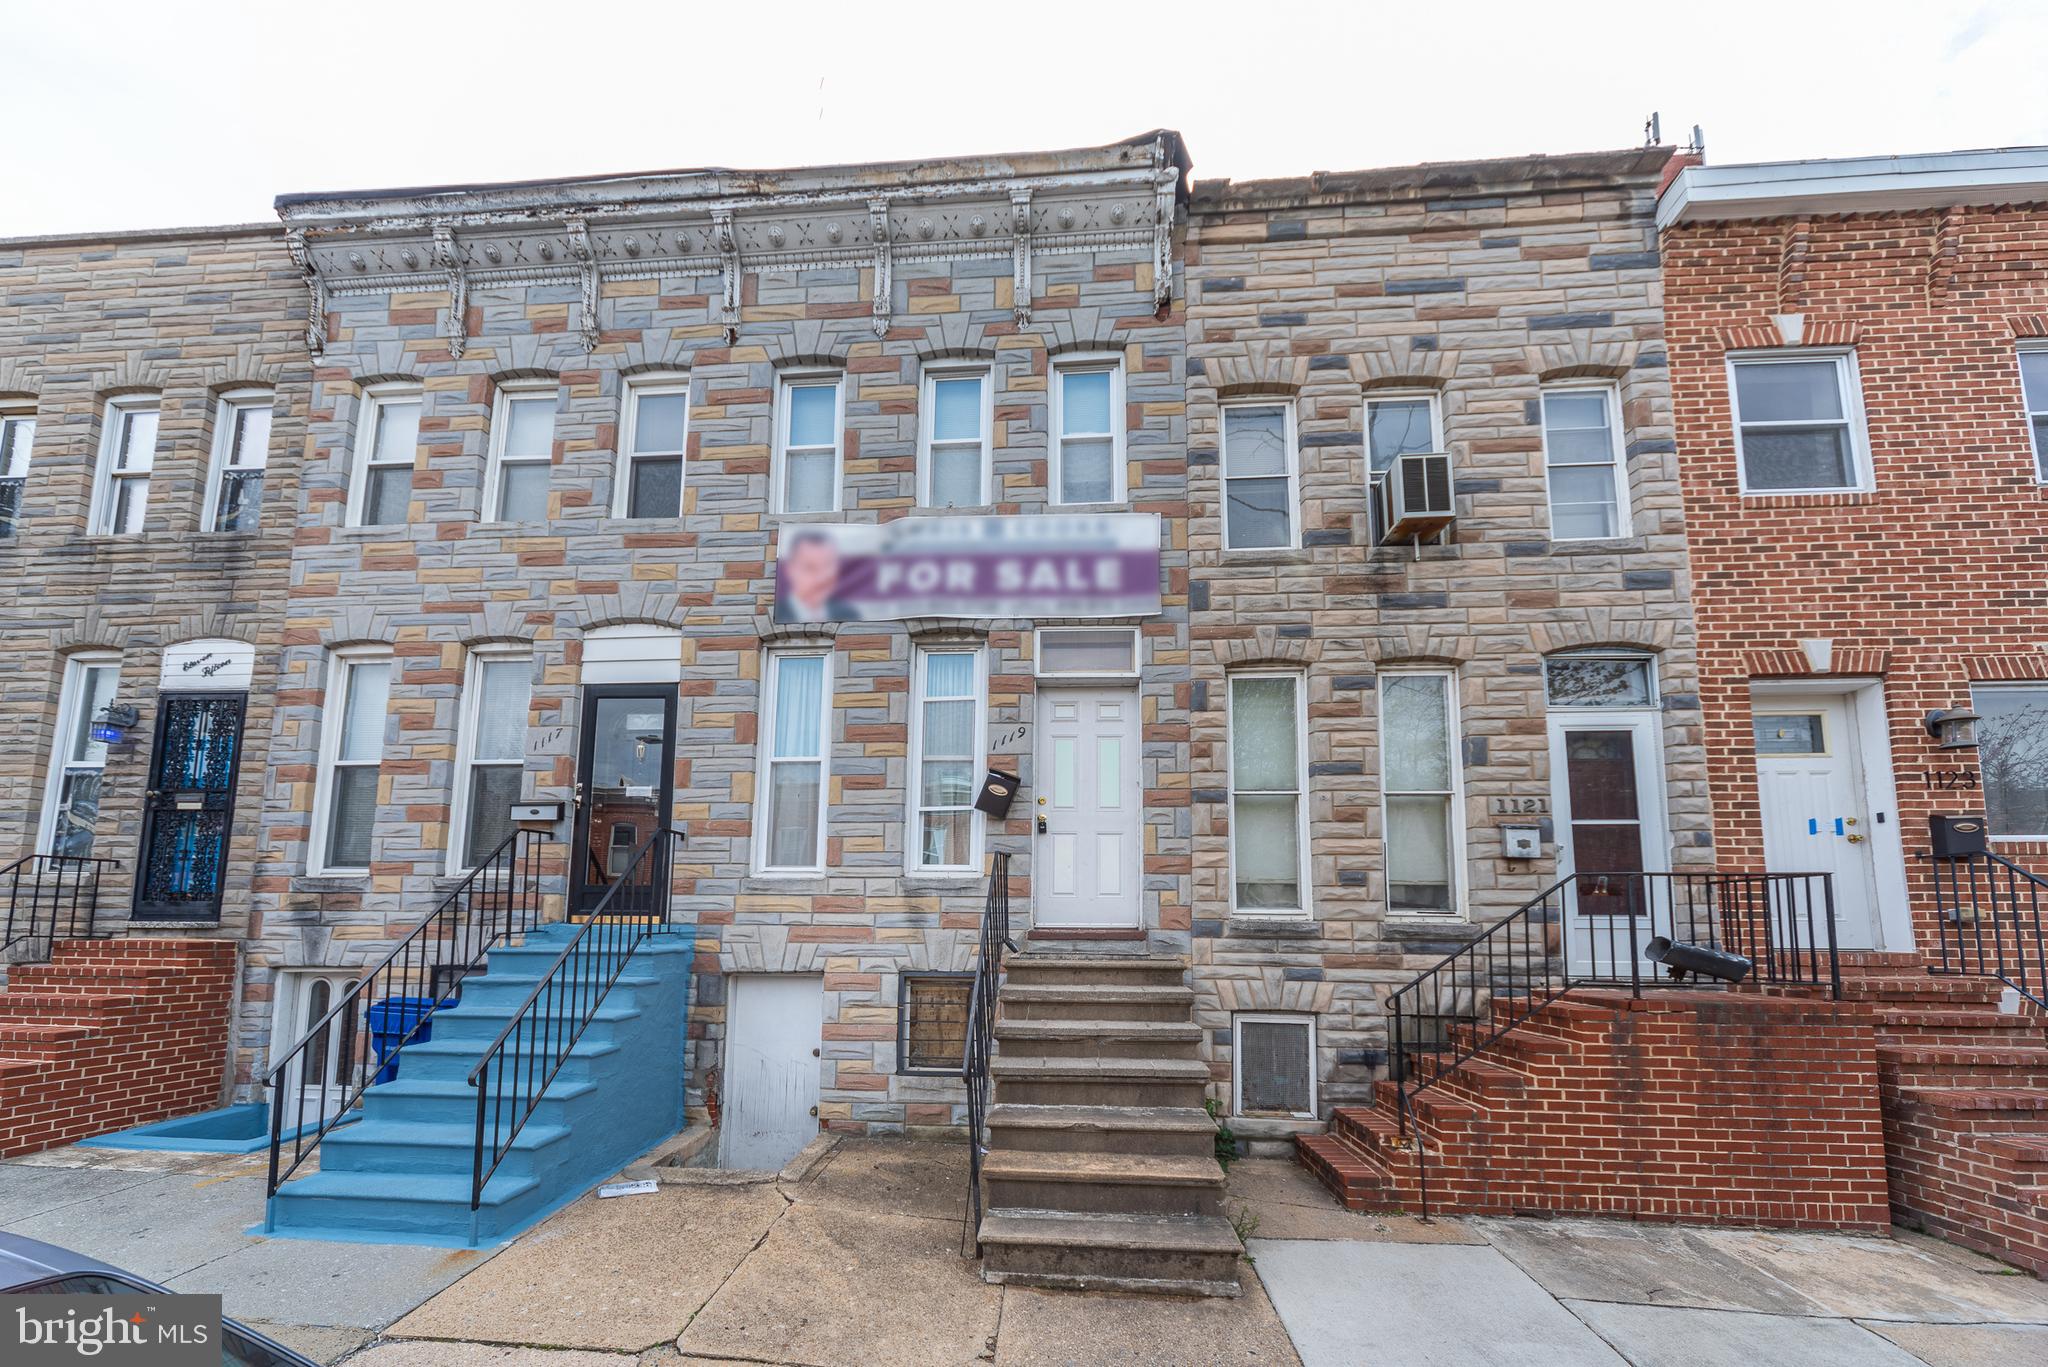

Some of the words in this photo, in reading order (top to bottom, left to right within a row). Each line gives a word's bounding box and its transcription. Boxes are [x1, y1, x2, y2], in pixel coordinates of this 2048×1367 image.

[875, 557, 976, 594] FOR
[995, 556, 1122, 592] SALE
[533, 727, 564, 752] 1117
[992, 726, 1026, 751] 1119
[1922, 770, 1976, 789] 1123
[1496, 798, 1549, 814] 1121
